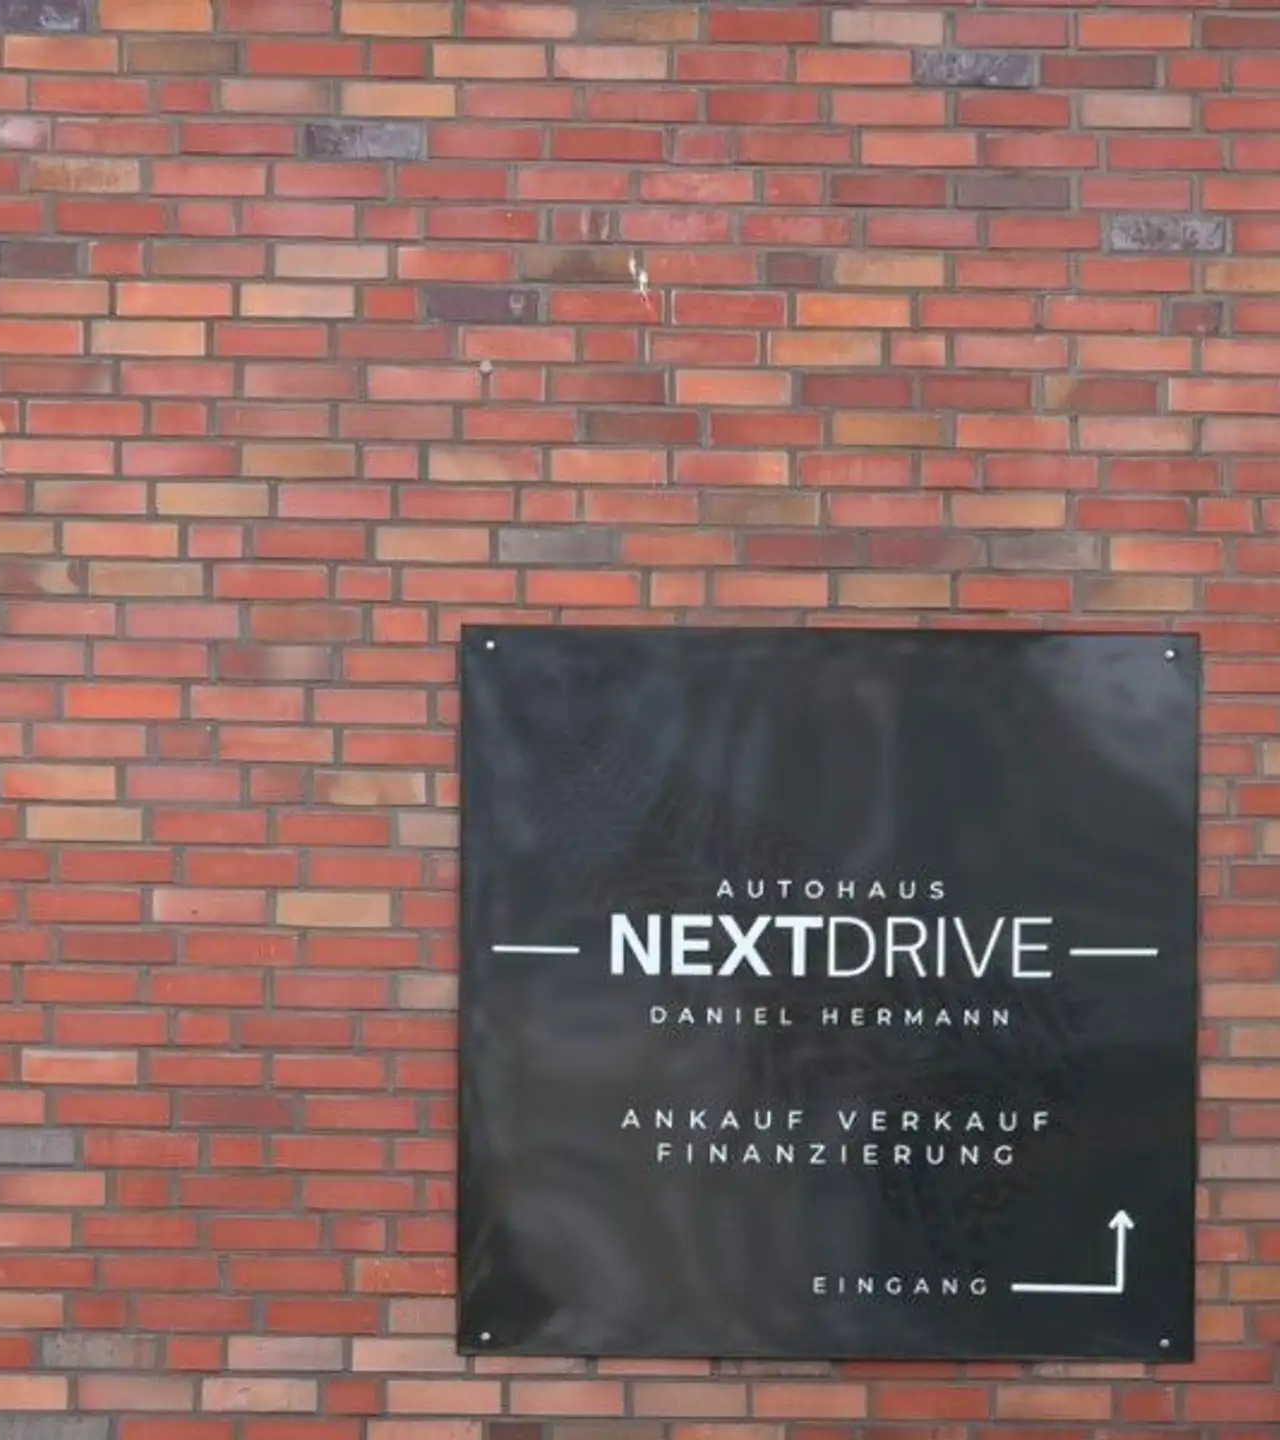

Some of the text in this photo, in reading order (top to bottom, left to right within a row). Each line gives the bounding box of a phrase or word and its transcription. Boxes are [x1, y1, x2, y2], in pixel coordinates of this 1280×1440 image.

[716, 879, 946, 901] AUTOHAUS
[610, 913, 1053, 979] NEXTDRIVE
[649, 1005, 1011, 1027] DANIEL HERMANN
[620, 1108, 1050, 1133] ANKAUF VERKAUF
[656, 1142, 1015, 1166] FINANZIERUNG
[812, 1276, 989, 1296] EINGANG
